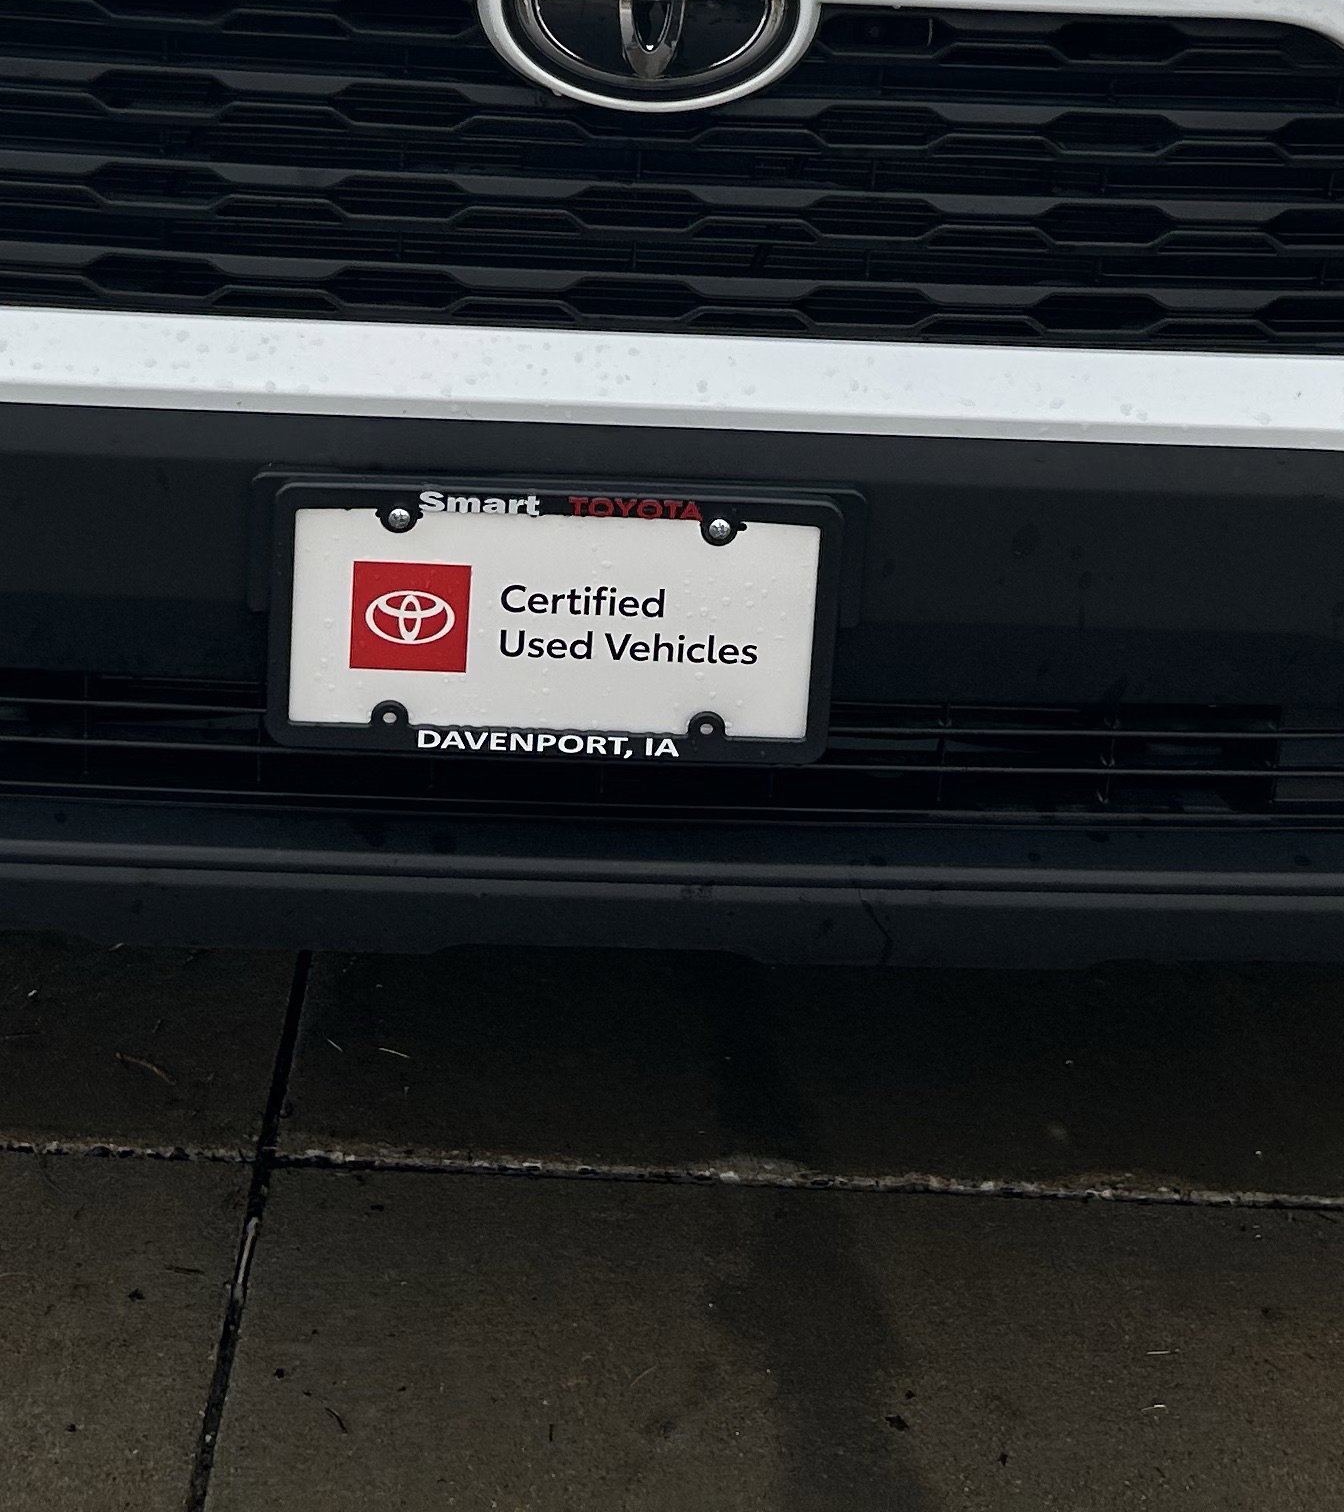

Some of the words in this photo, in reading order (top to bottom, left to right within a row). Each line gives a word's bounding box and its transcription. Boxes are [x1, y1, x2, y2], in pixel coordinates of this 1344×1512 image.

[418, 491, 540, 516] Smart
[568, 496, 702, 521] TOYOTA
[499, 584, 666, 619] Certified
[498, 629, 594, 662] Used
[604, 633, 759, 666] Vehicles
[417, 729, 632, 759] DAVENPORT,
[645, 737, 680, 758] IA
